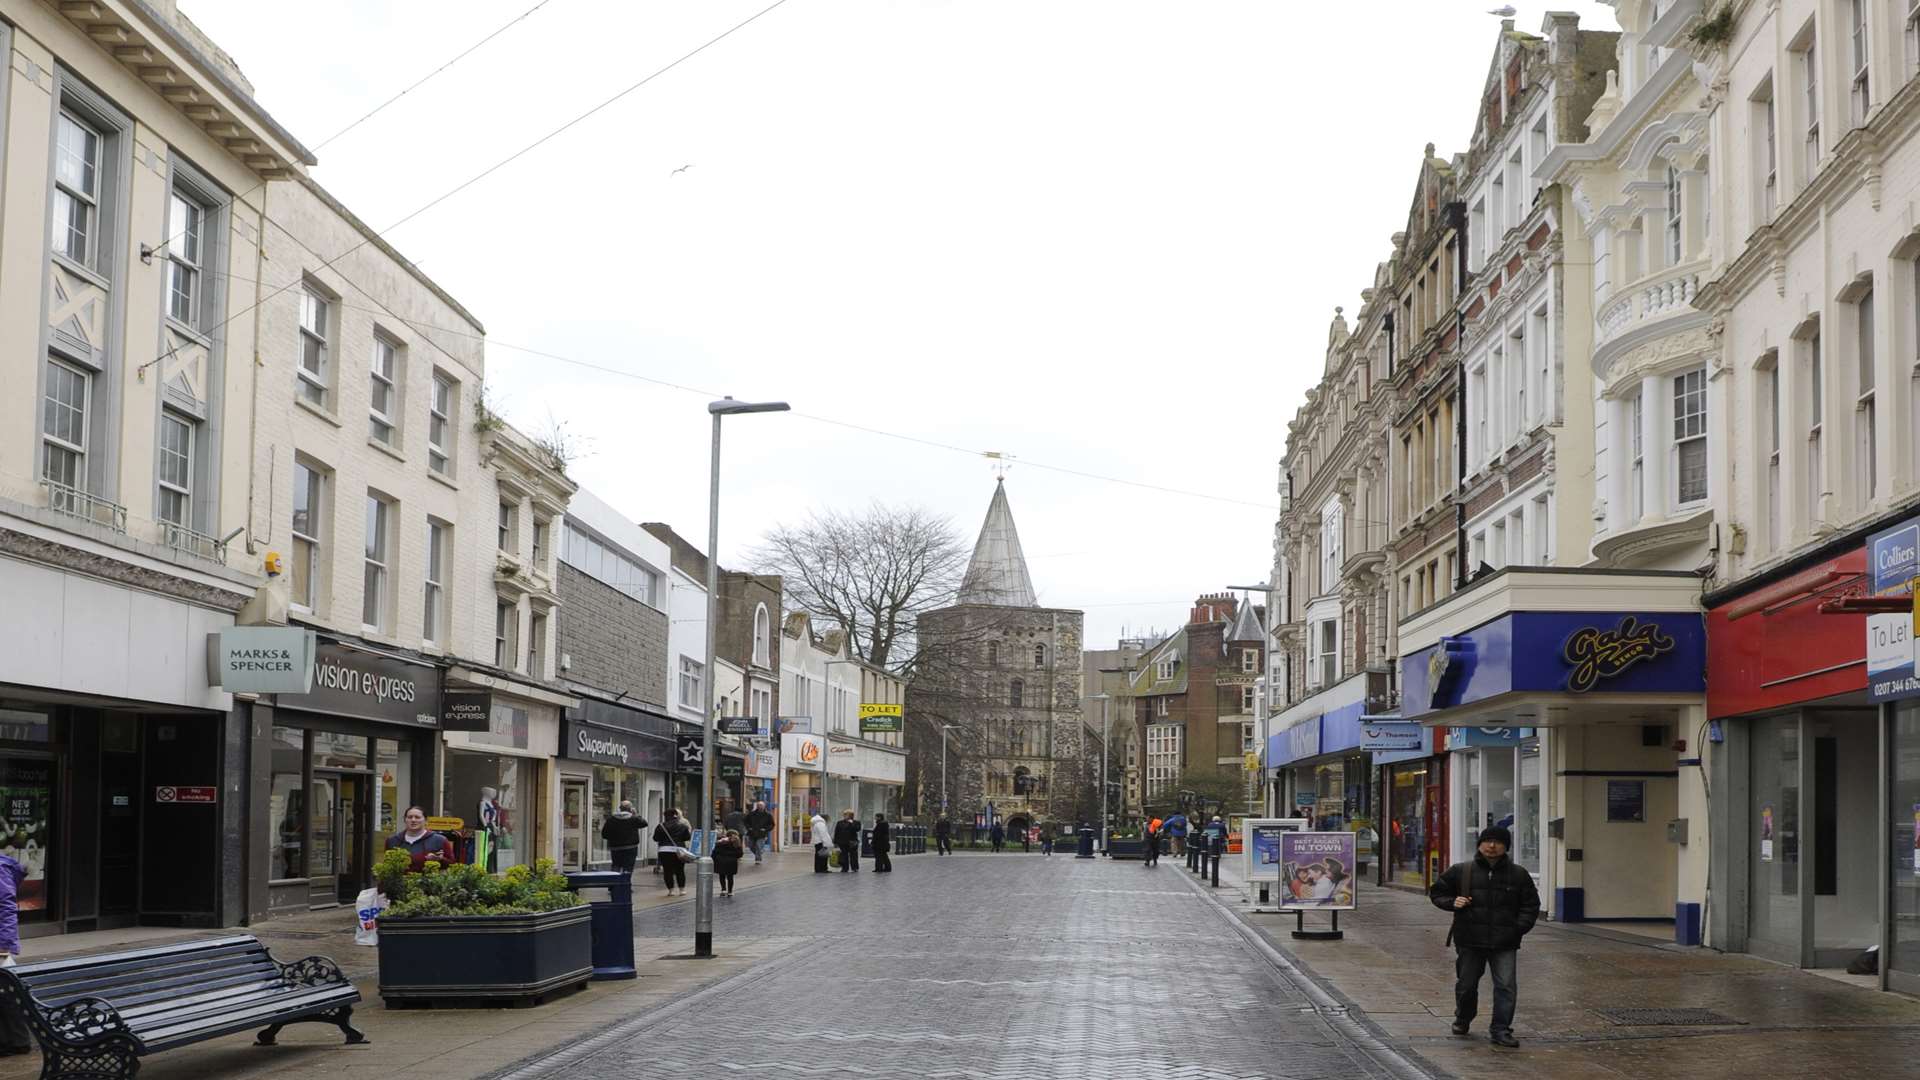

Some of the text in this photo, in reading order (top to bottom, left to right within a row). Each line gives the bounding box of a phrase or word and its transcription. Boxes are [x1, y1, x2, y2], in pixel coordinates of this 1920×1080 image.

[1879, 546, 1915, 570] Colliers
[1872, 621, 1907, 648] To Let
[230, 649, 290, 659] MARKS &
[230, 661, 292, 671] SPENCER
[315, 656, 416, 703] vision express
[1891, 679, 1904, 694] 344
[451, 704, 481, 712] vision
[860, 705, 875, 713] TO
[445, 711, 487, 721] express
[578, 729, 629, 765] Superdrug
[12, 799, 31, 808] NEW
